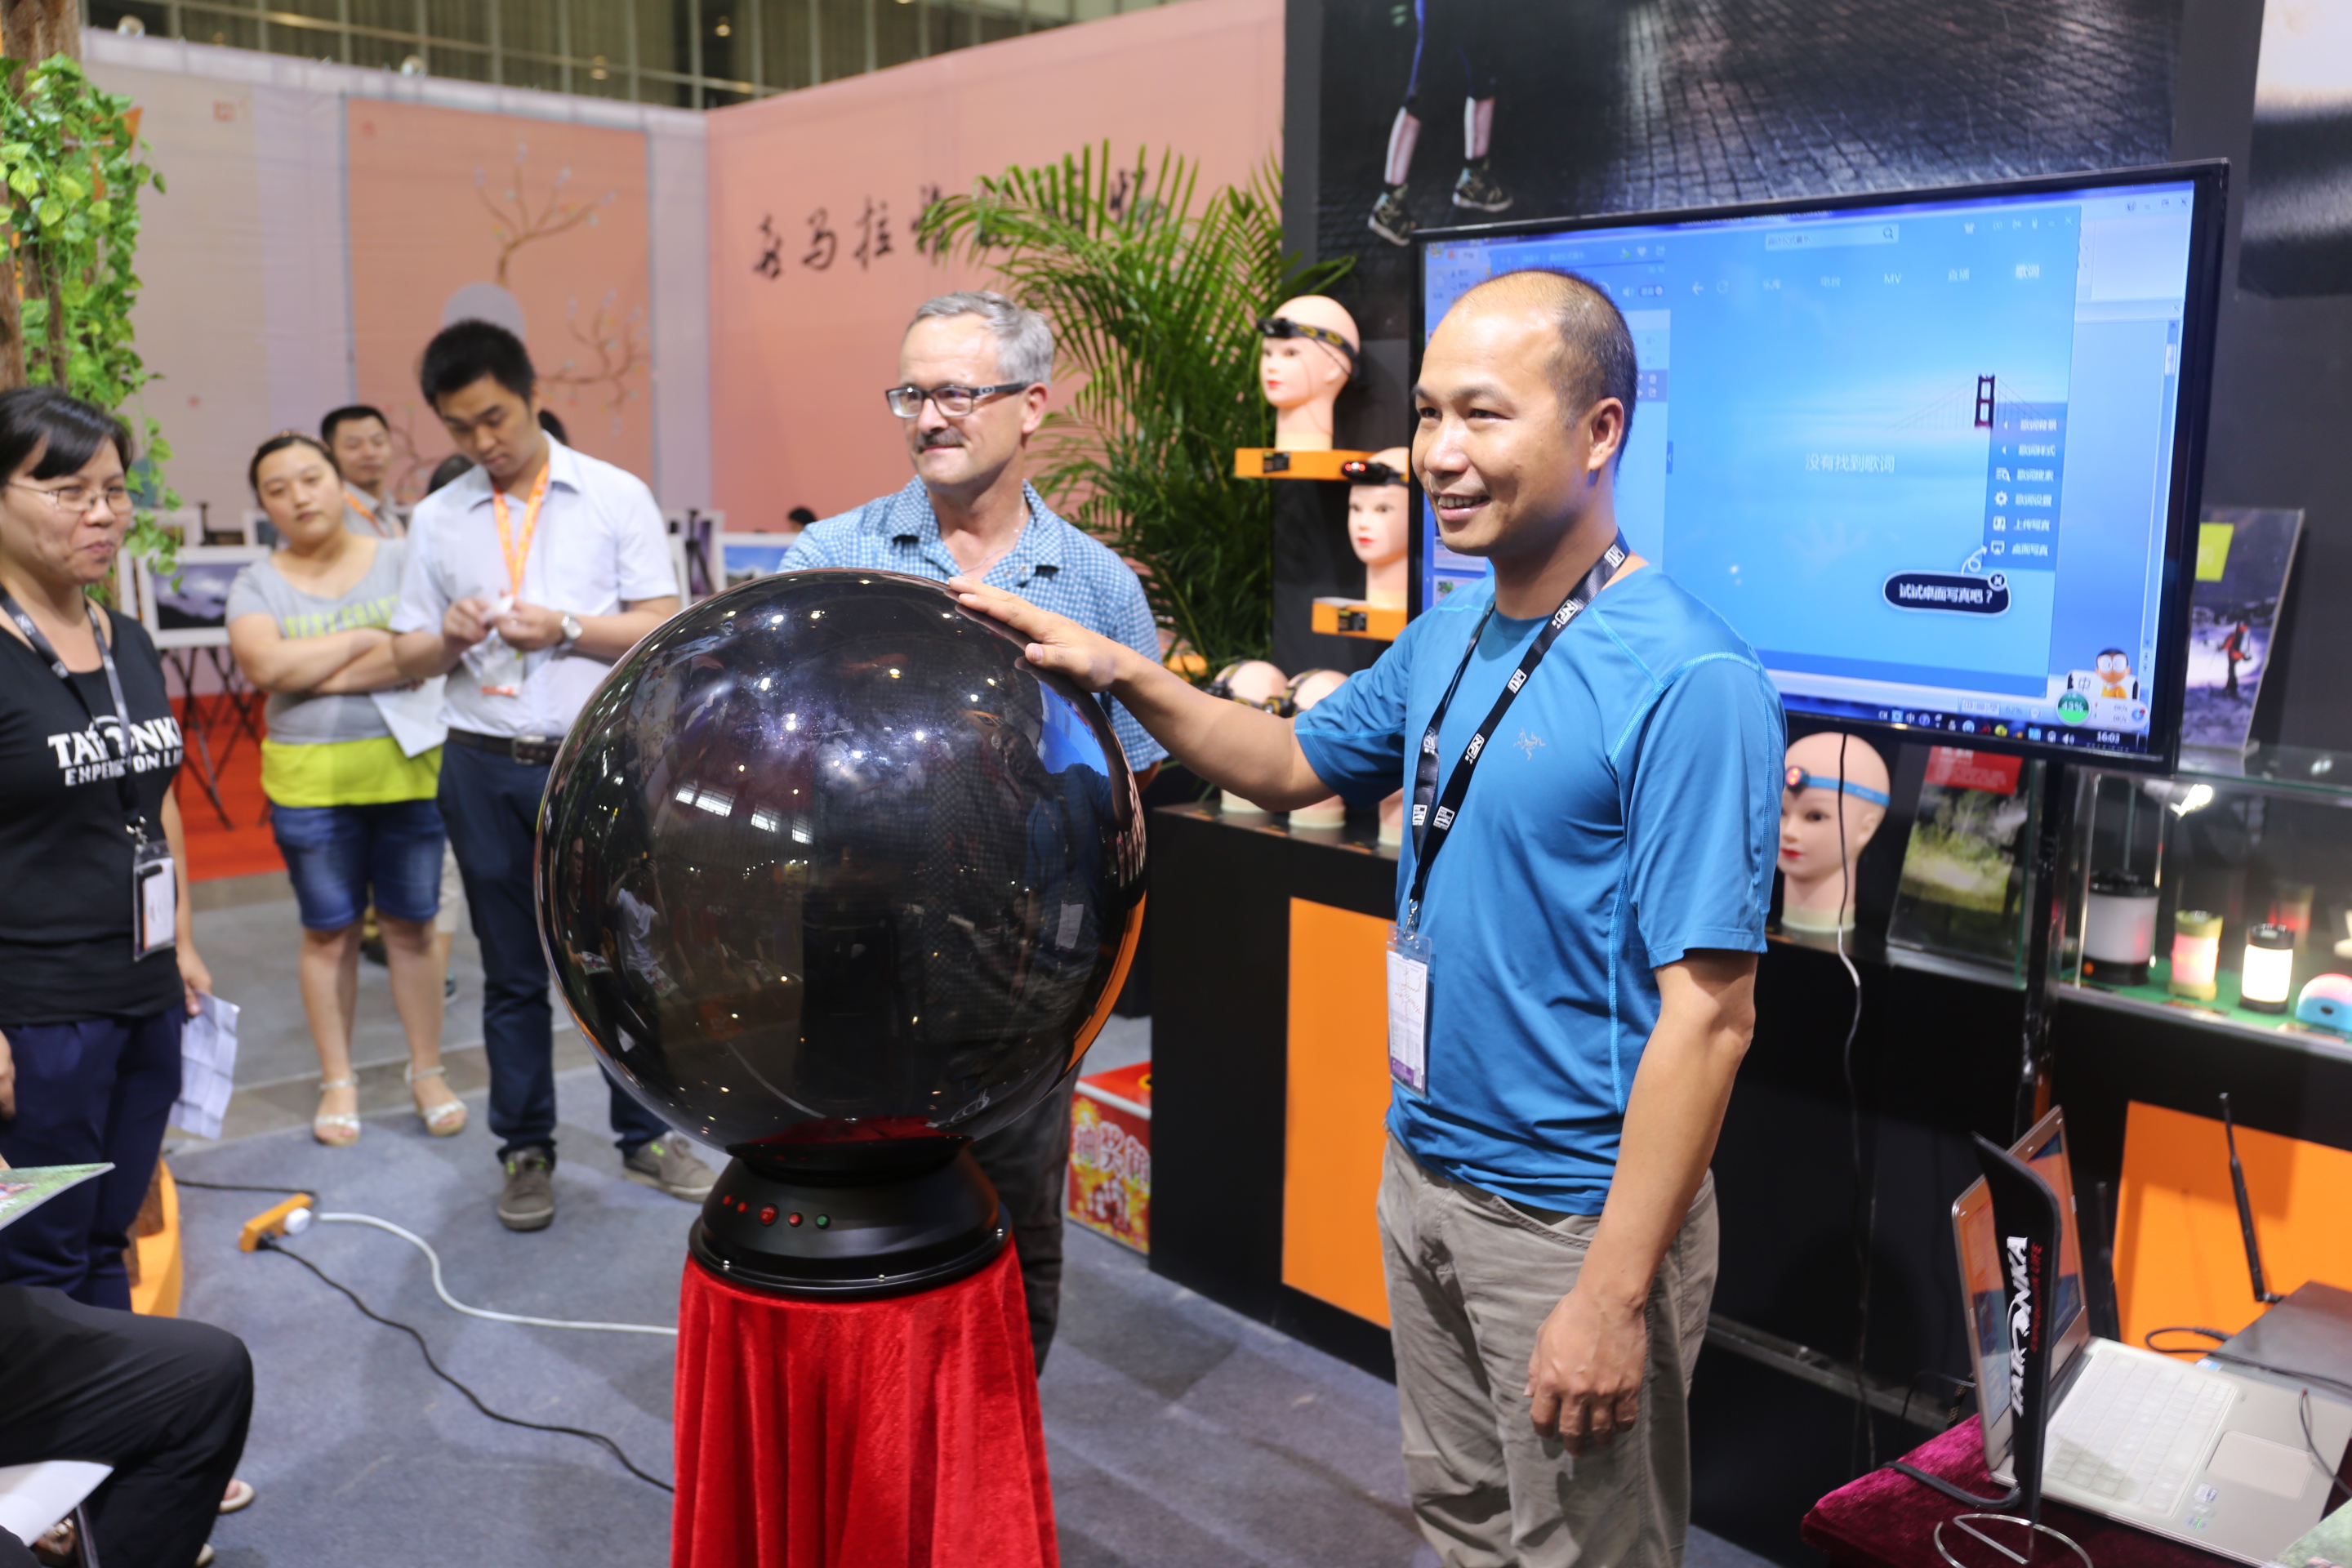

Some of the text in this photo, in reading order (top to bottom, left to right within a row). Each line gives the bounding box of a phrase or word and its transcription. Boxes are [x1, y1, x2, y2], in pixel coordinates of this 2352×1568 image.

[1884, 272, 1902, 285] MV
[2016, 264, 2040, 279] 歌词
[1805, 452, 1895, 473] 没有找到歌词
[2078, 675, 2091, 692] 中
[2096, 731, 2121, 744] 16:03
[2029, 1241, 2043, 1274] LIFE
